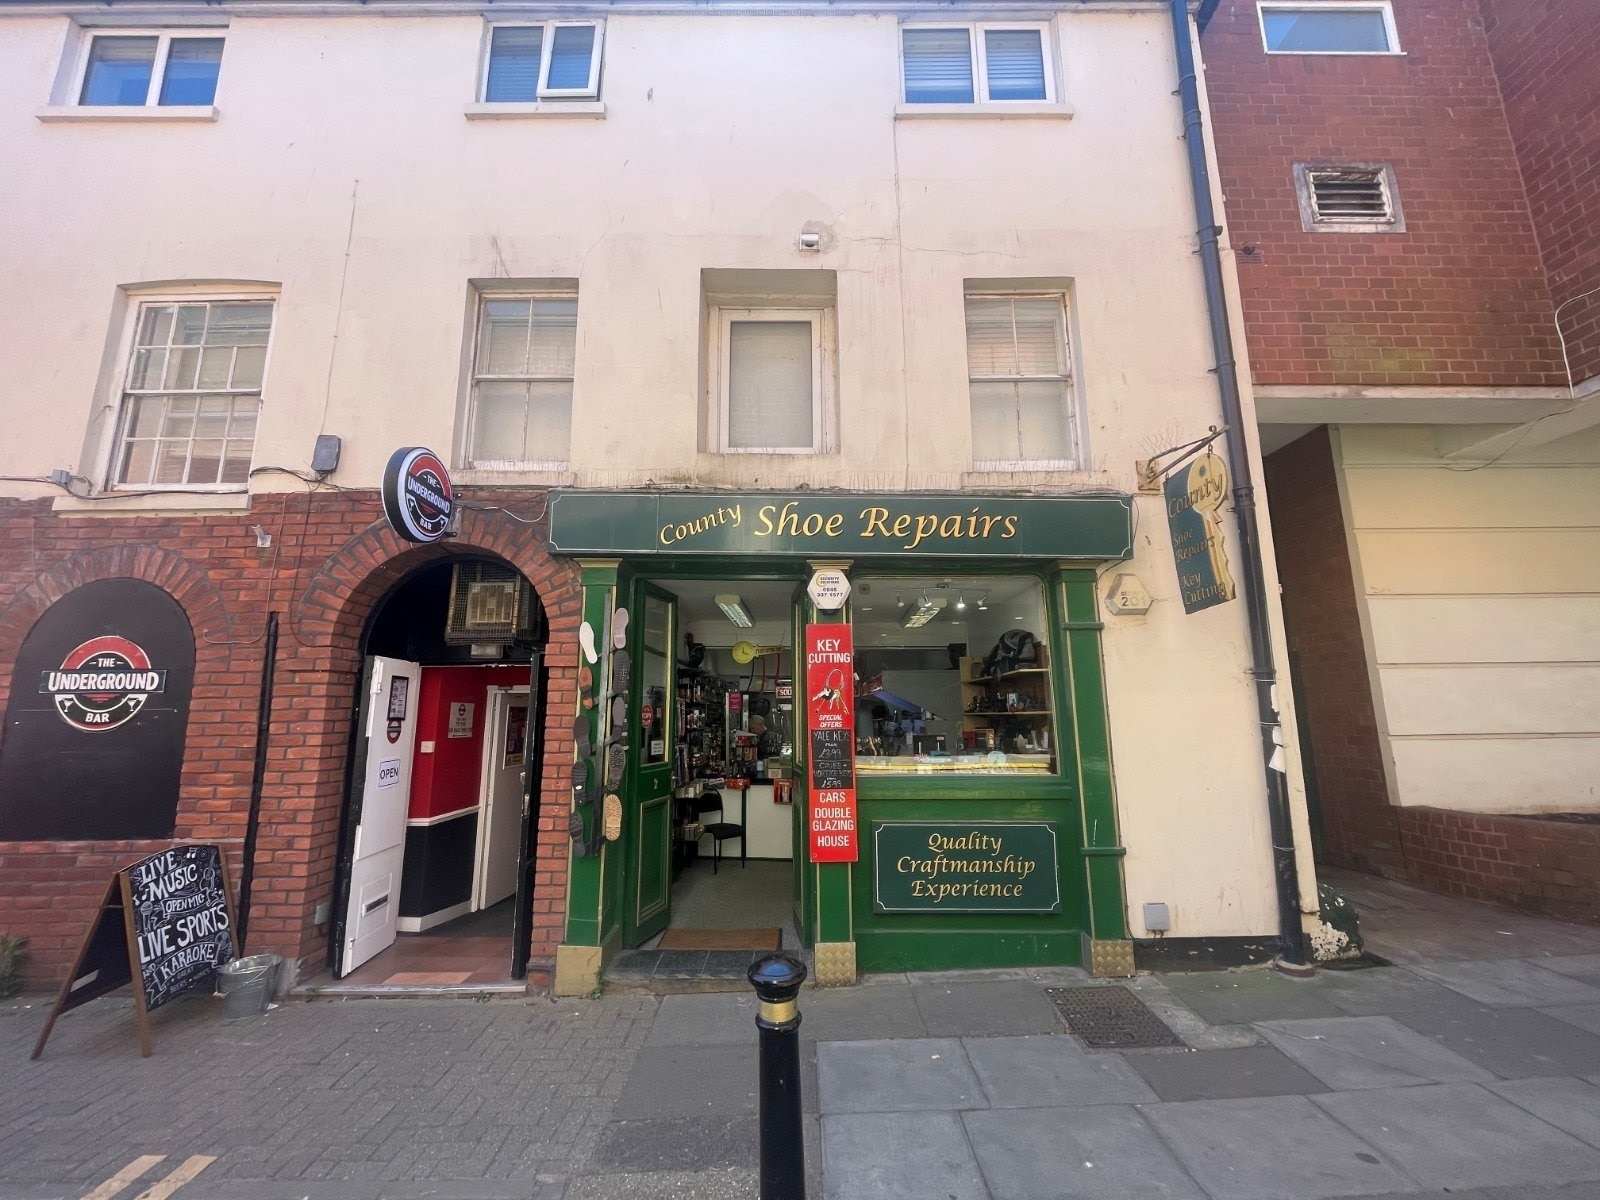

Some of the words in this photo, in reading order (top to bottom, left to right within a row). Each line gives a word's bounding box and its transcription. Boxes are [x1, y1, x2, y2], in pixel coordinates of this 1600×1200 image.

[427, 475, 437, 488] THE
[408, 476, 450, 513] UNDERGROUND
[1168, 474, 1222, 518] County
[420, 518, 432, 531] BAR
[659, 504, 742, 545] County
[753, 502, 844, 538] Shoe
[859, 505, 1019, 550] Repairs
[1174, 527, 1193, 547] Shoe
[1176, 536, 1215, 563] Repairs
[1181, 572, 1201, 588] Key
[1184, 581, 1227, 605] Cutting
[817, 639, 841, 652] KEY
[98, 658, 116, 667] THE
[808, 653, 851, 664] CUTTING
[48, 671, 160, 692] UNDERGROUND
[85, 712, 110, 723] BAR
[813, 730, 830, 741] YALE
[380, 767, 399, 780] OPEN
[653, 778, 659, 790] 2
[819, 792, 846, 803] CARS
[814, 807, 852, 819] DOUBLE
[812, 820, 854, 832] GLAZING
[817, 835, 850, 847] HOUSE
[928, 831, 1003, 856] Quality
[140, 851, 178, 884] LIVE
[897, 854, 1036, 880] Craftmanship
[149, 864, 198, 902] MUSIC
[911, 879, 1023, 903] Experience
[165, 898, 187, 913] OPEN
[188, 893, 205, 909] MIC
[137, 925, 176, 964] LIVE
[176, 904, 230, 947] SPORTS
[160, 943, 215, 980] KARAOKE
